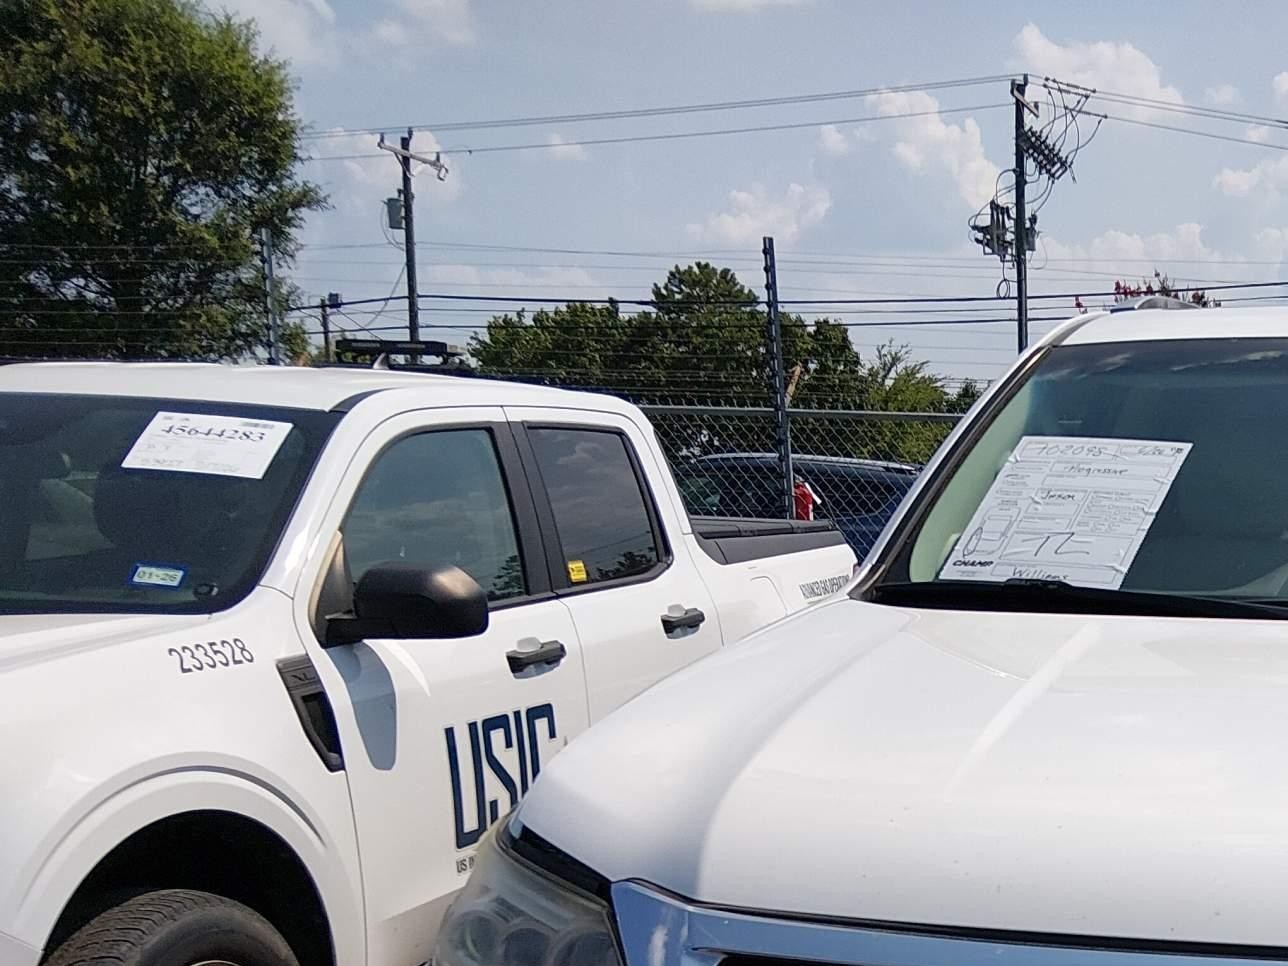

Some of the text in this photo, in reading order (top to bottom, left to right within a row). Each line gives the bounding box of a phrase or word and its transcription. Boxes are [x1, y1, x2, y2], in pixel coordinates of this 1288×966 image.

[161, 425, 267, 443] 45644283
[952, 559, 994, 568] CHAMP
[168, 638, 254, 673] 233528
